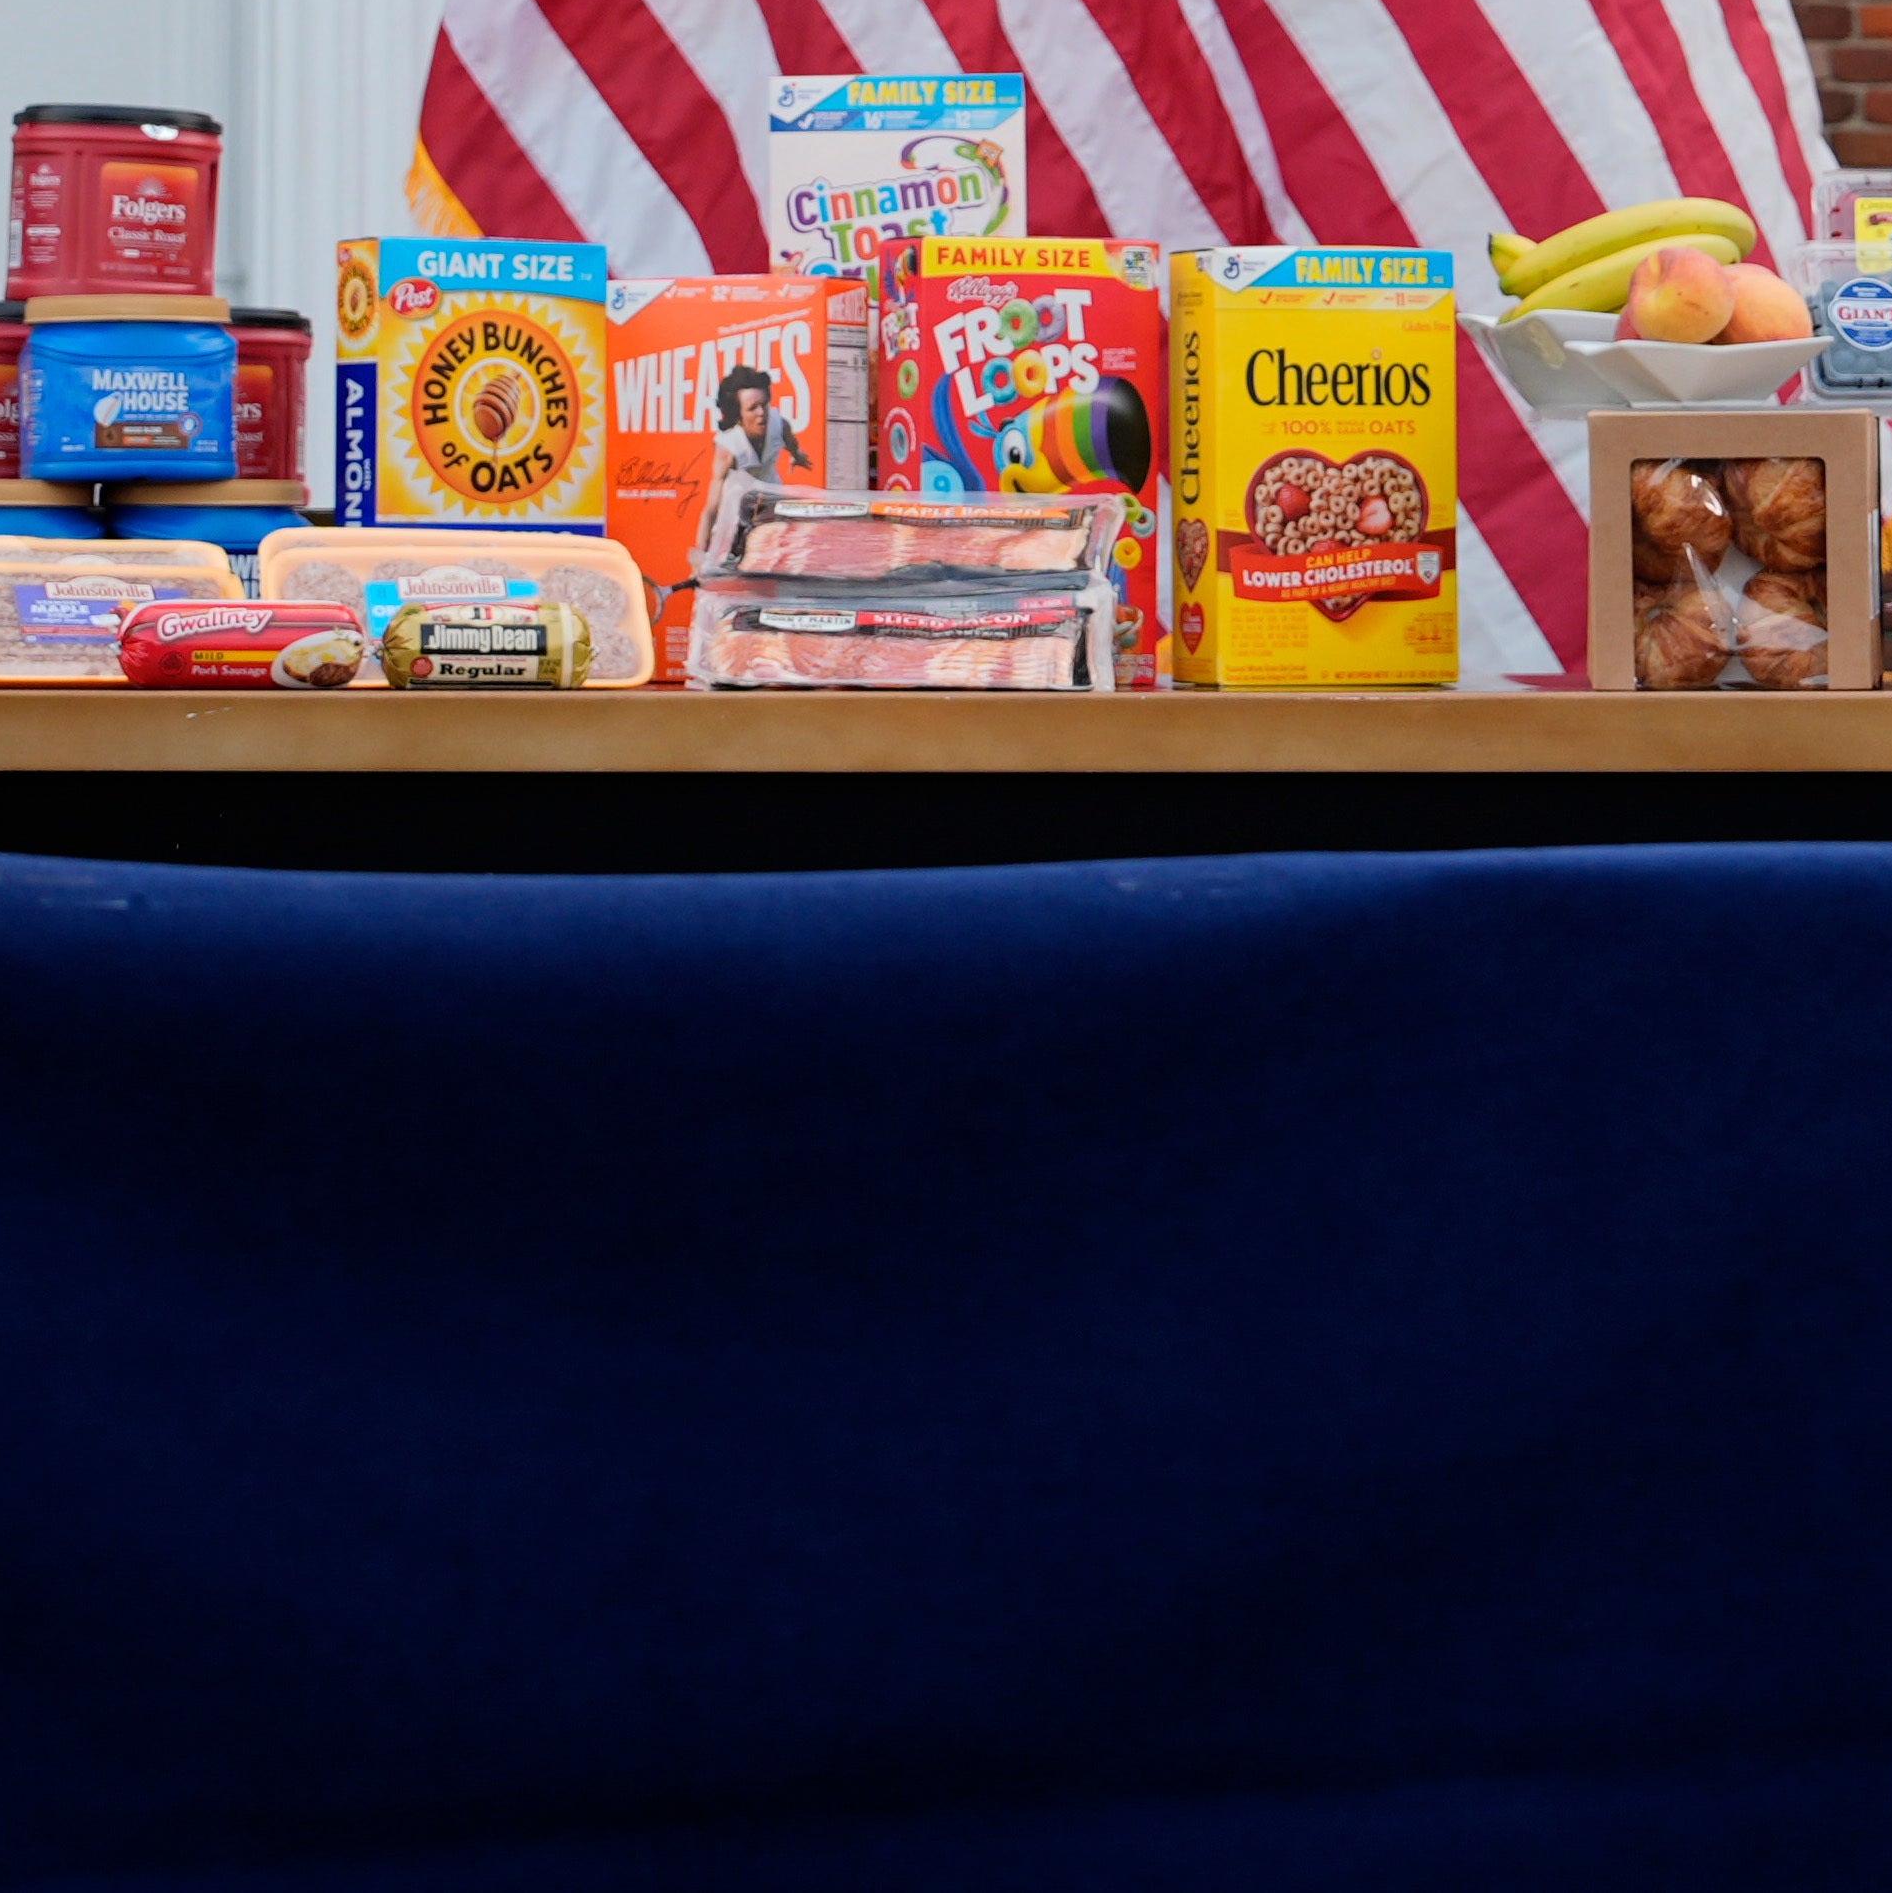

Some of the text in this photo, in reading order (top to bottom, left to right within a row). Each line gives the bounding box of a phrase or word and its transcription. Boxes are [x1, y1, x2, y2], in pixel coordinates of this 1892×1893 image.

[848, 81, 996, 106] FAMILY SIZE
[112, 195, 187, 225] Folgers
[795, 172, 982, 225] Cinnamon
[108, 227, 187, 243] Classic Roast
[417, 251, 574, 282] GIANT SIZE
[937, 247, 1090, 268] FAMILY SIZE
[1295, 257, 1428, 283] FAMILY SIZE
[394, 283, 434, 311] Post
[947, 276, 1019, 305] Kellogg's
[933, 289, 1092, 374] FROOT
[92, 369, 188, 390] MAXWELL
[423, 321, 568, 429] HONEY BUNCHES
[954, 343, 1100, 417] LOOPS
[1246, 348, 1431, 406] Cheerios
[123, 392, 189, 411] HOUSE
[1181, 330, 1201, 505] Cheerios
[1282, 420, 1416, 435] 100% OATS
[344, 378, 364, 527] ALMON
[442, 442, 554, 493] of OATS
[884, 506, 1043, 517] MAPLE BACON
[1306, 548, 1372, 567] CAN HELP
[1242, 559, 1413, 587] LOWER CHOLESTEROL
[53, 584, 149, 598] Johnsonville
[405, 578, 500, 596] Johnsonville
[159, 609, 272, 640] Gwaltney
[807, 615, 853, 625] MARTIN
[873, 613, 1031, 627] SLICED BACON
[425, 625, 538, 653] Jimmy Dean
[194, 651, 224, 661] MILD
[191, 665, 267, 677] Pork Sausage
[440, 663, 526, 680] Regular
